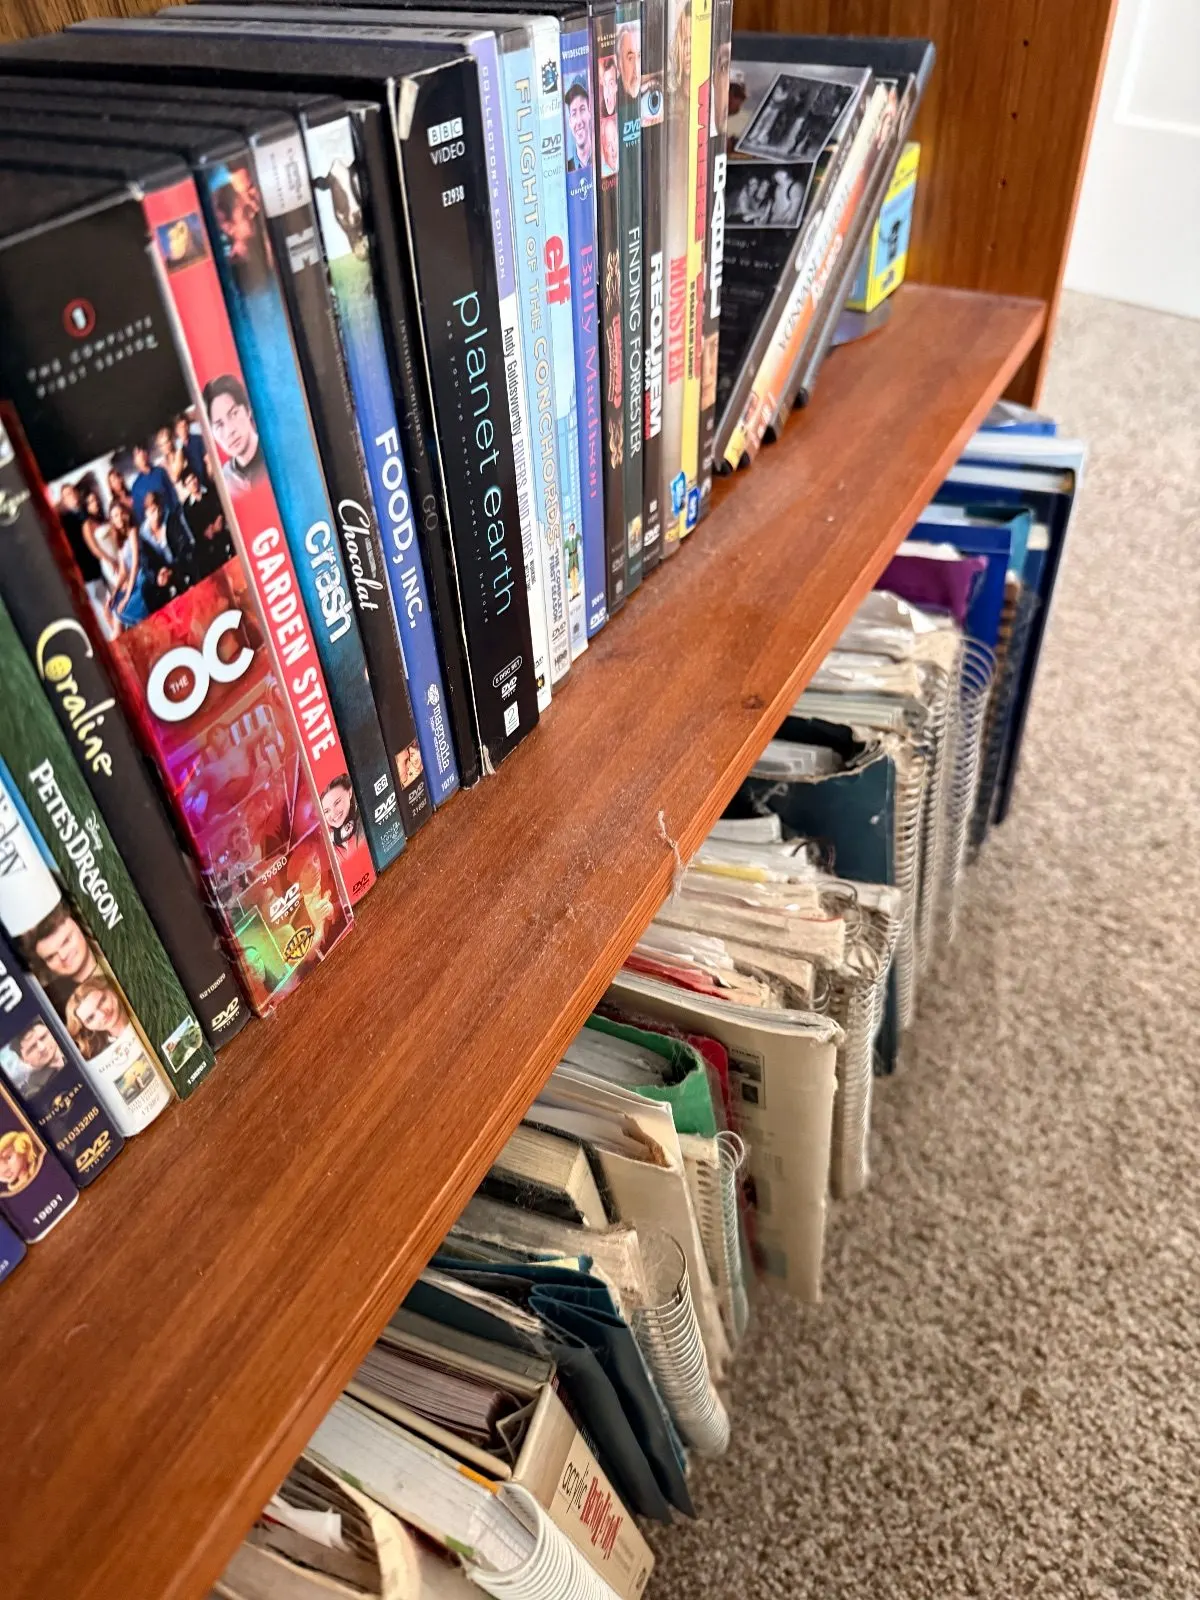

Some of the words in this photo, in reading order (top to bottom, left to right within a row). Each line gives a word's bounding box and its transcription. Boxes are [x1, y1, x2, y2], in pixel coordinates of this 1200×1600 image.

[428, 119, 463, 146] BBC
[430, 145, 466, 165] VIDEO
[514, 76, 540, 229] FLIGHT
[441, 185, 465, 207] E2938
[482, 66, 499, 198] COLLECTOR'S
[493, 207, 507, 279] EDITION
[523, 237, 538, 272] OF
[628, 226, 641, 333] FINDING
[528, 285, 542, 334] THE
[579, 245, 594, 333] Billy
[503, 325, 515, 357] Andy
[649, 251, 664, 440] REQUIEM
[504, 356, 524, 438] Goldsworthy
[628, 336, 643, 459] FORRESTER
[453, 290, 501, 475] planet
[484, 485, 515, 616] earth
[512, 437, 529, 490] RIVERS
[533, 336, 562, 547] CONCHORDS
[375, 426, 414, 565] FOOD,
[400, 565, 424, 629] INC.
[517, 491, 531, 521] AND
[338, 498, 384, 612] Chocolat
[518, 521, 535, 560] TIDES
[304, 520, 353, 644] Crash
[146, 608, 255, 723] OC
[251, 526, 310, 667] GARDEN
[292, 666, 336, 762] STATE
[36, 617, 116, 777] Coraline
[168, 674, 190, 696] THE
[501, 676, 518, 697] DVD
[433, 703, 450, 772] magnolia
[374, 791, 397, 823] DVD
[64, 834, 124, 930] DRAGON
[269, 882, 301, 923] DVD
[352, 872, 370, 895] DVD
[211, 997, 240, 1031] DVD
[75, 1129, 111, 1173] DVD
[562, 1461, 590, 1514] acrylic
